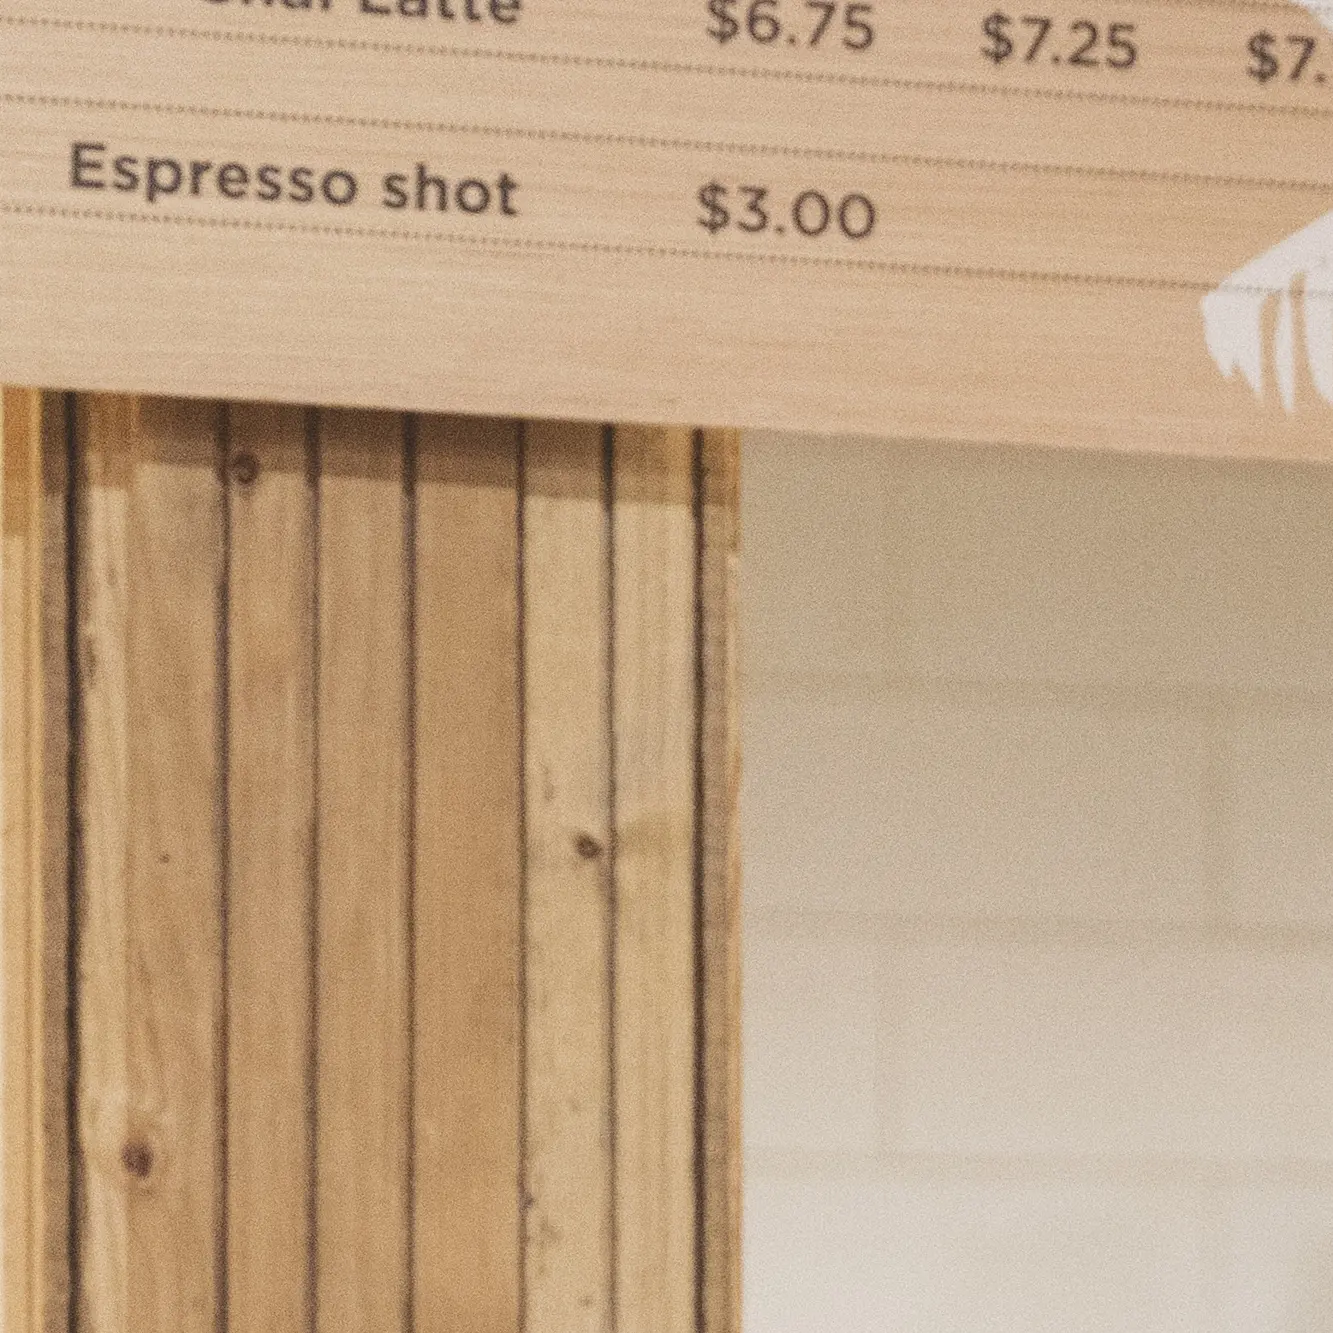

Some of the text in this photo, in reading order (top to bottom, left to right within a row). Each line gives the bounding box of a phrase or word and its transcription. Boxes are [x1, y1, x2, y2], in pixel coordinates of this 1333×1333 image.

[706, 0, 875, 52] $6.75
[982, 11, 1138, 71] $7.25
[70, 141, 878, 241] Espresso shot $3.00
